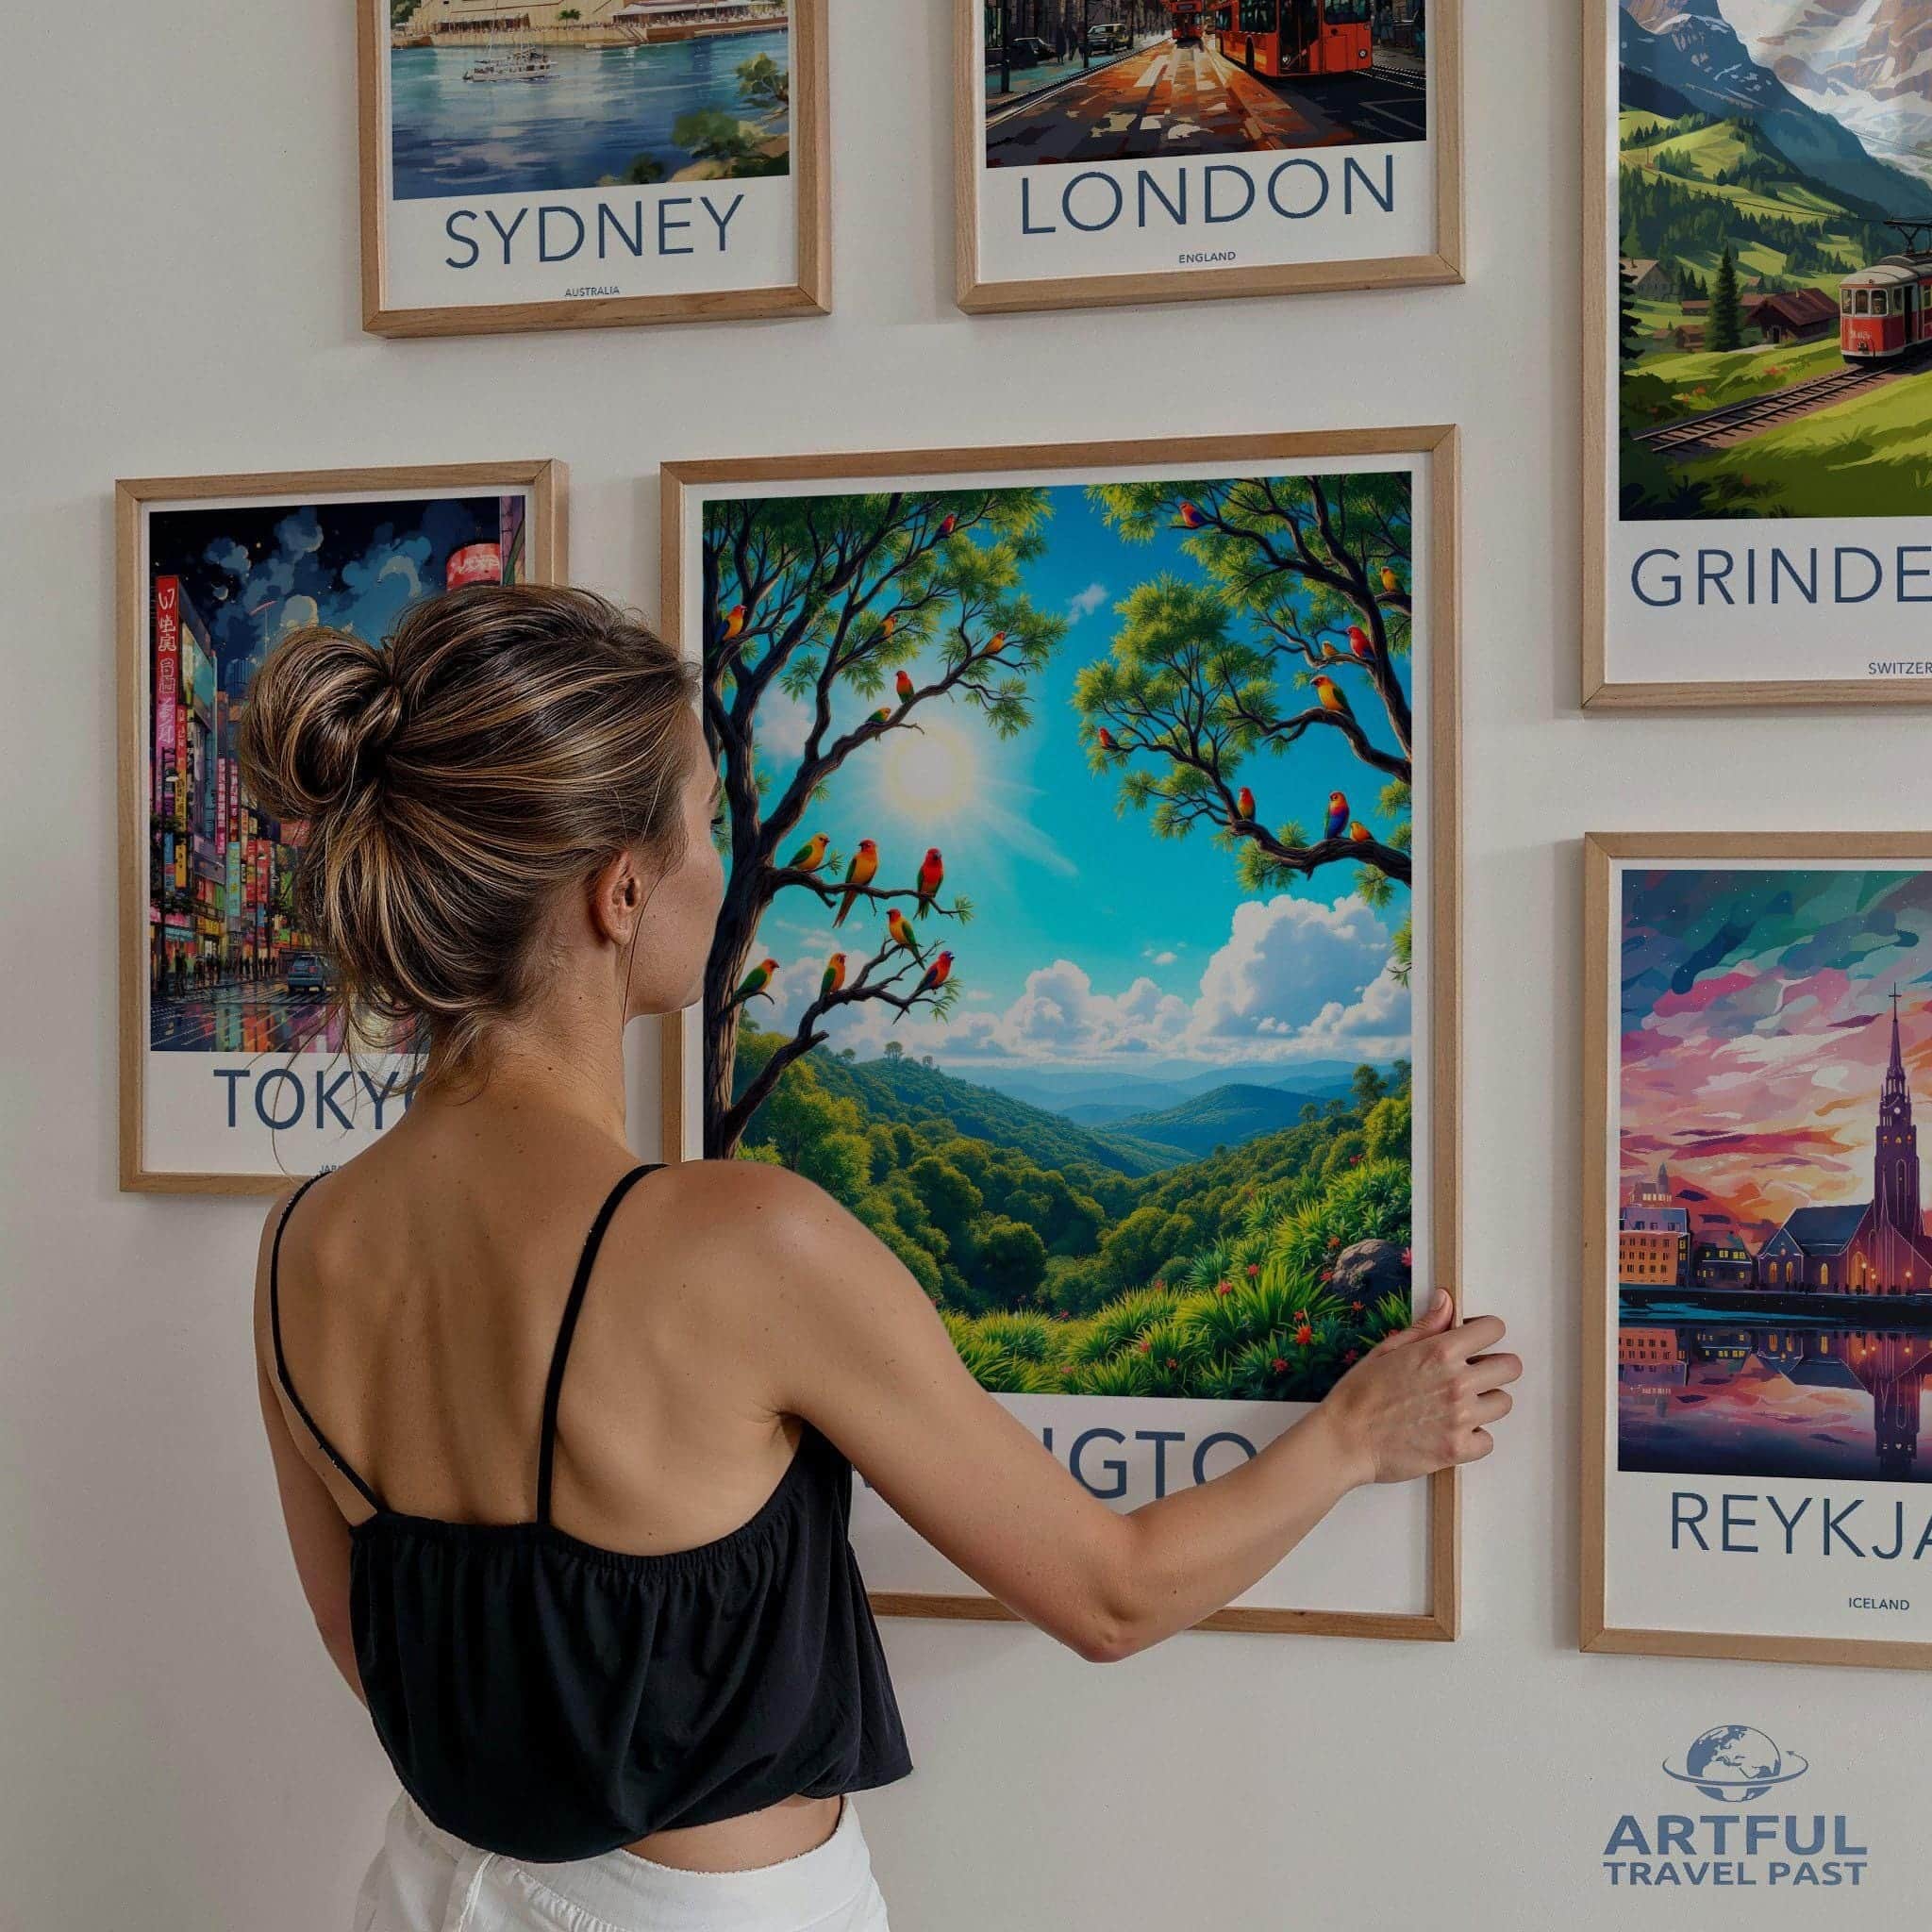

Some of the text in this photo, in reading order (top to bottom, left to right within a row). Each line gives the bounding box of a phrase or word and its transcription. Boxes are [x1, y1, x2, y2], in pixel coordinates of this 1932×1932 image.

[1022, 155, 1393, 234] LONDON
[445, 194, 744, 269] SYDNEY
[1179, 251, 1236, 263] ENGLAND
[565, 286, 620, 297] AUSTRALIA
[1631, 546, 1932, 607] GRINDE
[1848, 1597, 1910, 1610] ICELAND
